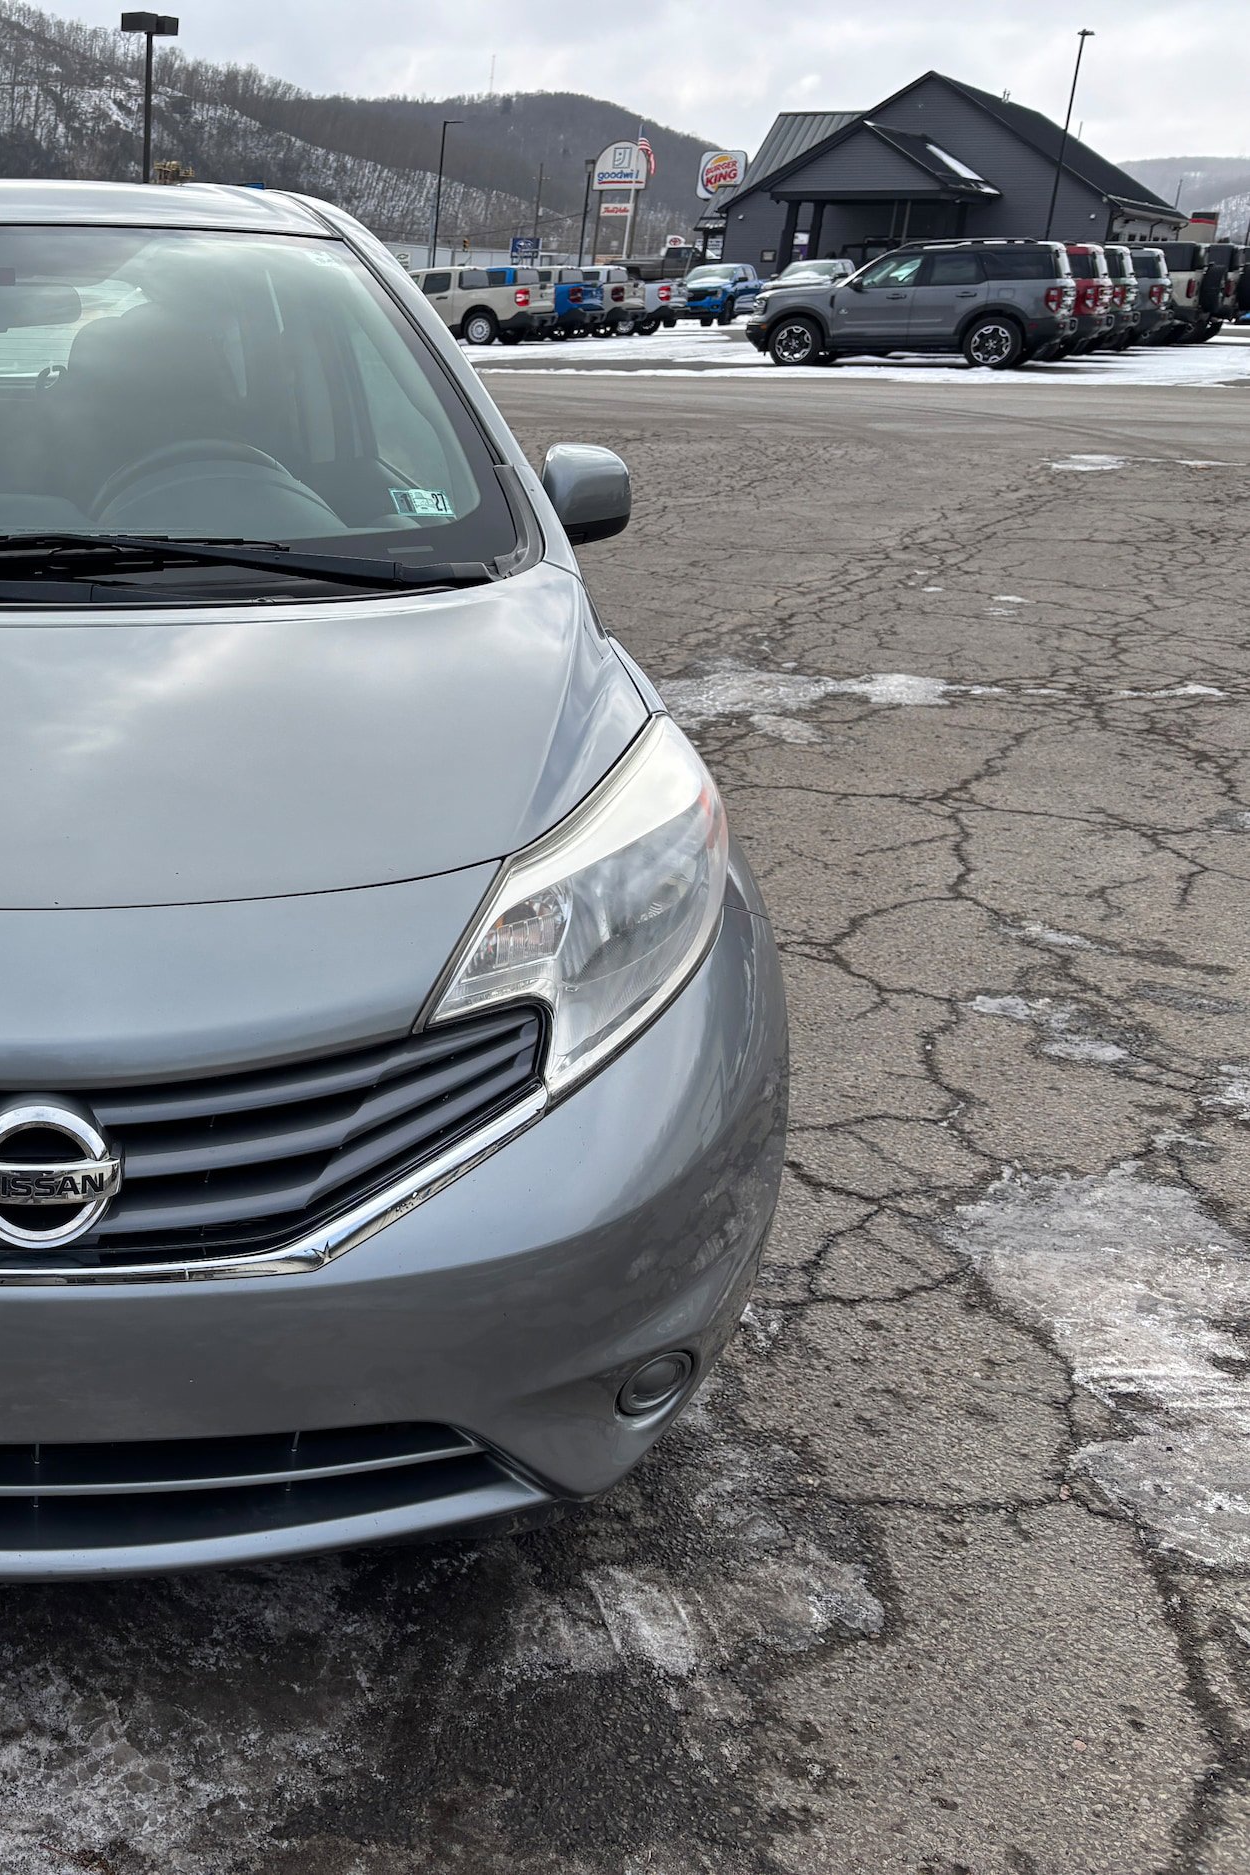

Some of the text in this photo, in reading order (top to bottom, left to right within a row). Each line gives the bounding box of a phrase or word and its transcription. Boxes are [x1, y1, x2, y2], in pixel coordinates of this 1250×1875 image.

[705, 160, 738, 176] BURGER
[705, 168, 738, 187] KING
[431, 493, 448, 512] 27
